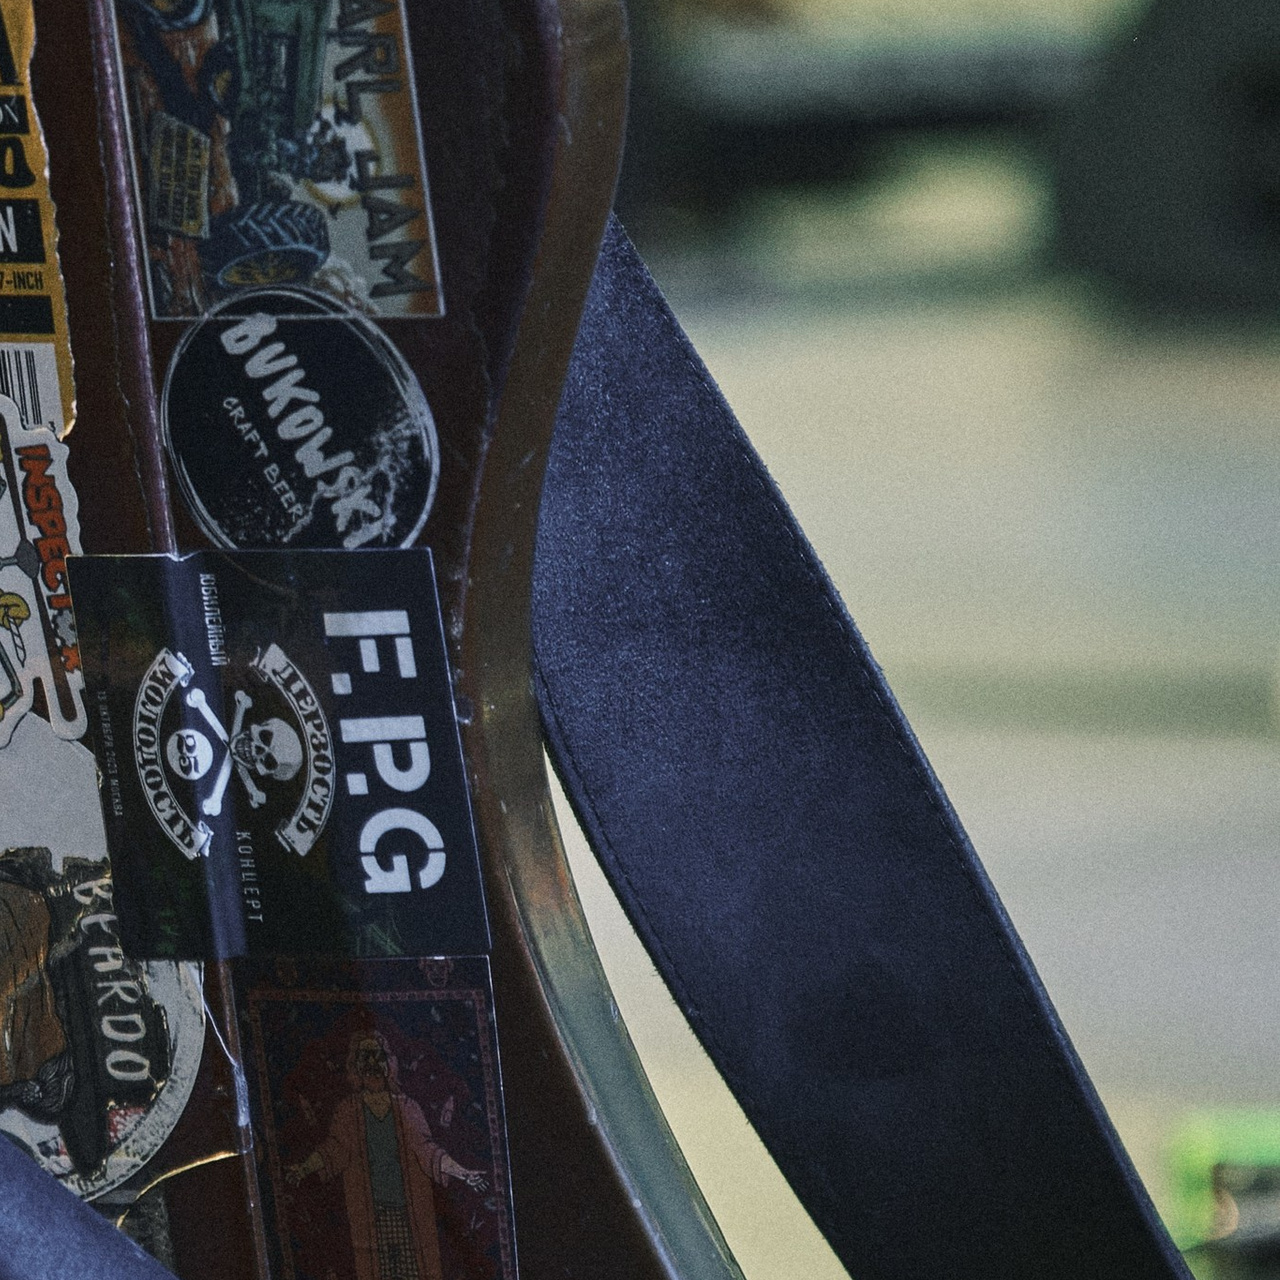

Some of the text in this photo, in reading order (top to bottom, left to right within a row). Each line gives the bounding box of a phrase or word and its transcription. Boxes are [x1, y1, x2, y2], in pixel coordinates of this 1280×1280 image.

[349, 150, 433, 300] JAM
[220, 312, 384, 549] BUKOWSKI
[222, 396, 305, 523] CRAFT BEER
[199, 572, 230, 668] ЮБИЛЕЙНЫЙ
[136, 658, 196, 851] МОЛОДОСТЬ
[175, 733, 201, 777] 25
[272, 661, 333, 836] ДЕРЗОСТЬ
[235, 830, 264, 923] КОНЦЕРТ
